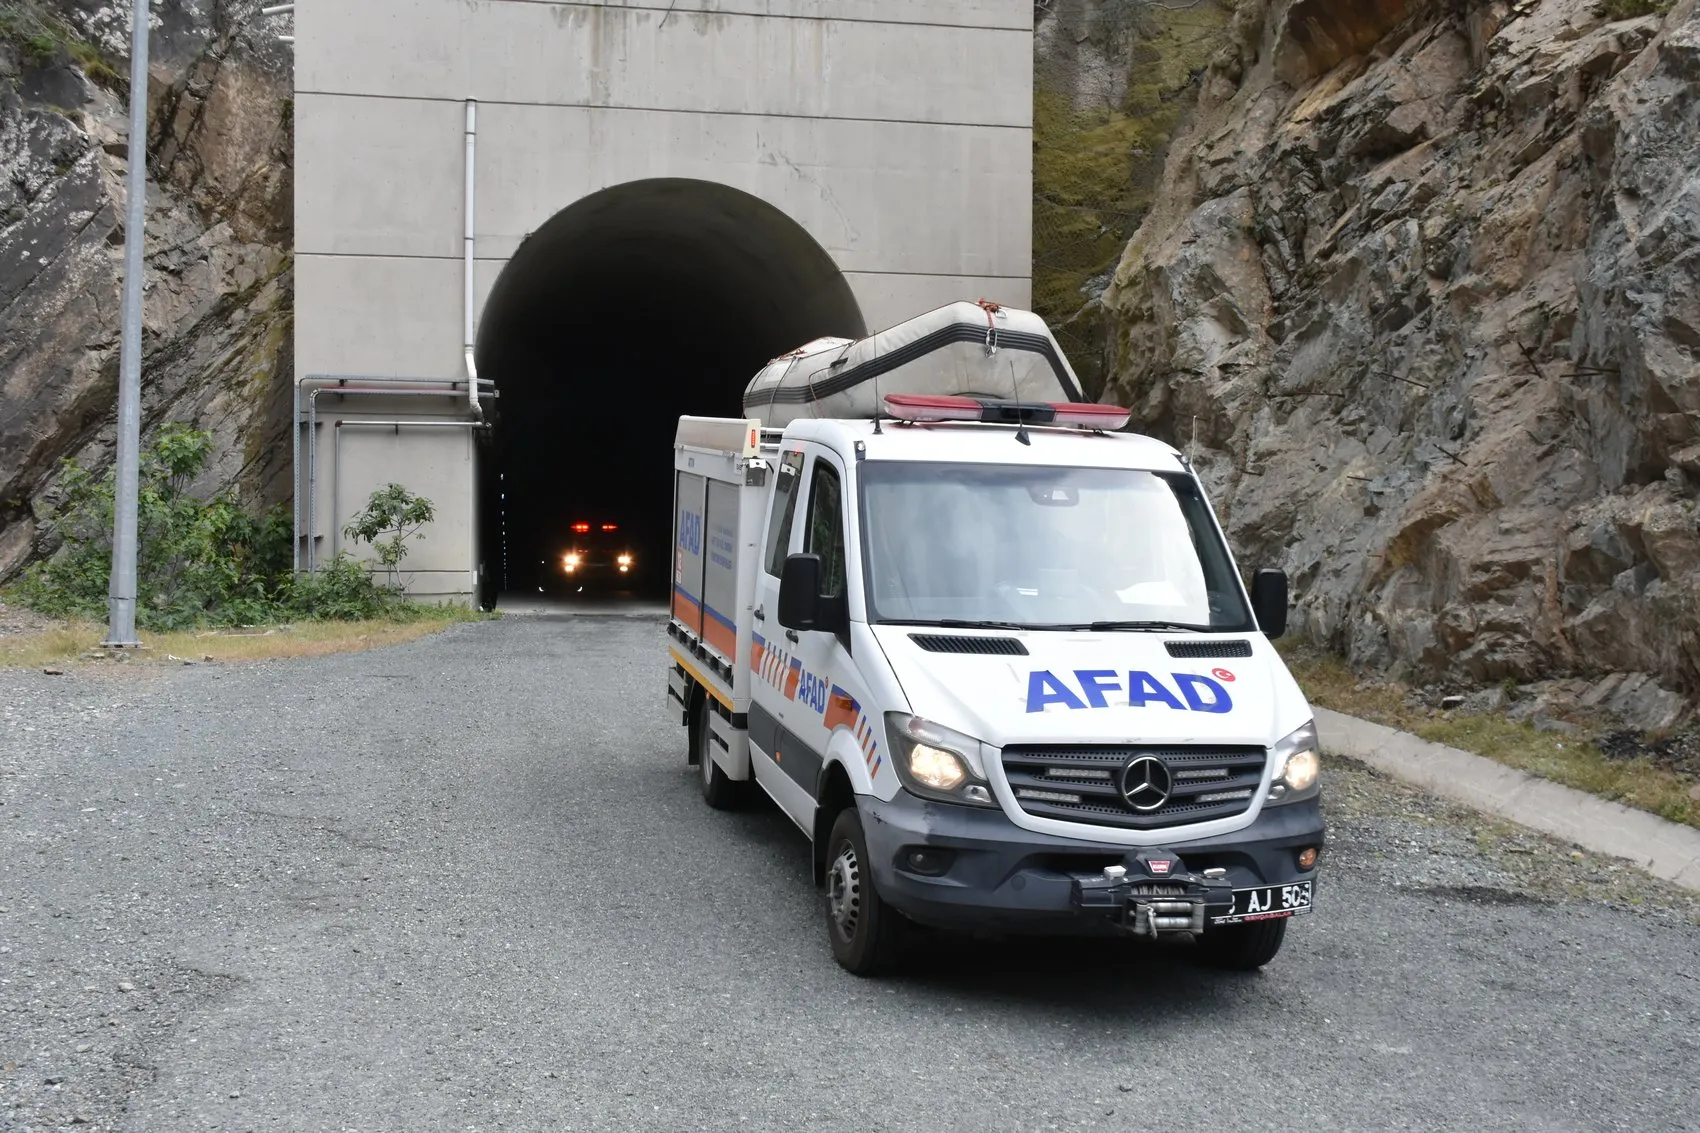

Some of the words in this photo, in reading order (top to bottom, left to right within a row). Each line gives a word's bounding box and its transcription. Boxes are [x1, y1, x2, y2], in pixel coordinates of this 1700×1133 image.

[680, 510, 700, 555] AFAD
[799, 669, 826, 714] AFAD
[1026, 670, 1233, 714] AFAD
[1248, 889, 1272, 913] AJ
